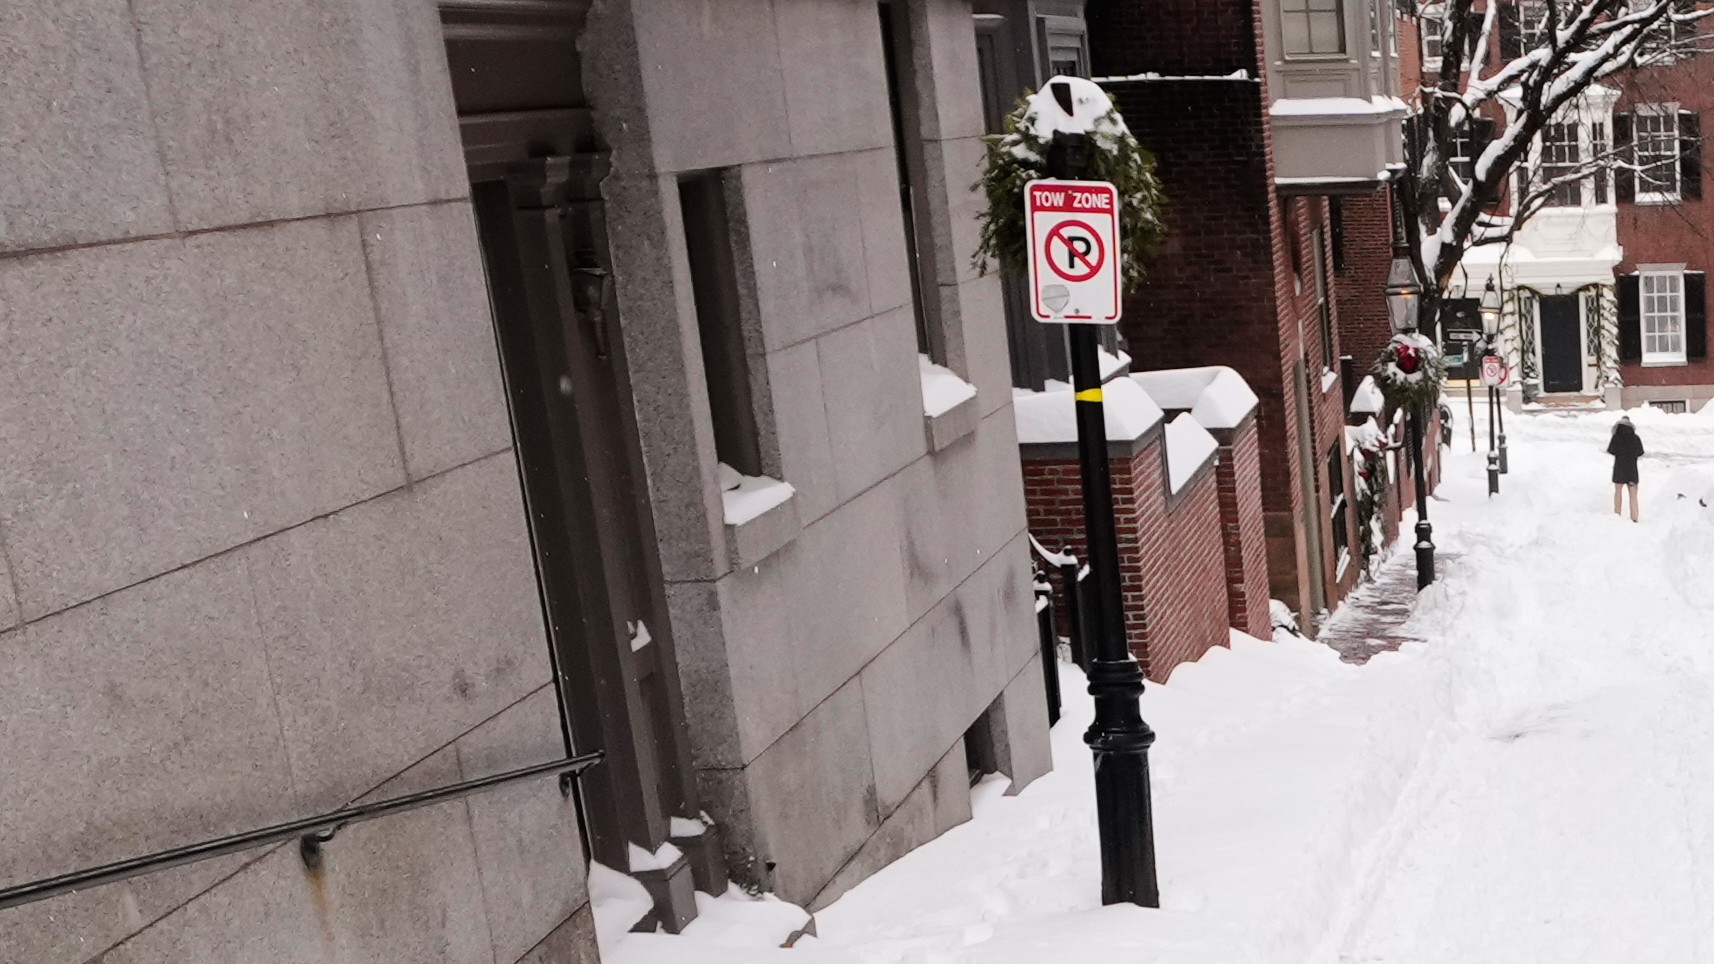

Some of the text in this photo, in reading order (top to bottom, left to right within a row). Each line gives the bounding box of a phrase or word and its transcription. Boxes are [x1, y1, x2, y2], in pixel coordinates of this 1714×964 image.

[1033, 191, 1111, 209] TOW ZONE
[1067, 236, 1092, 269] P
